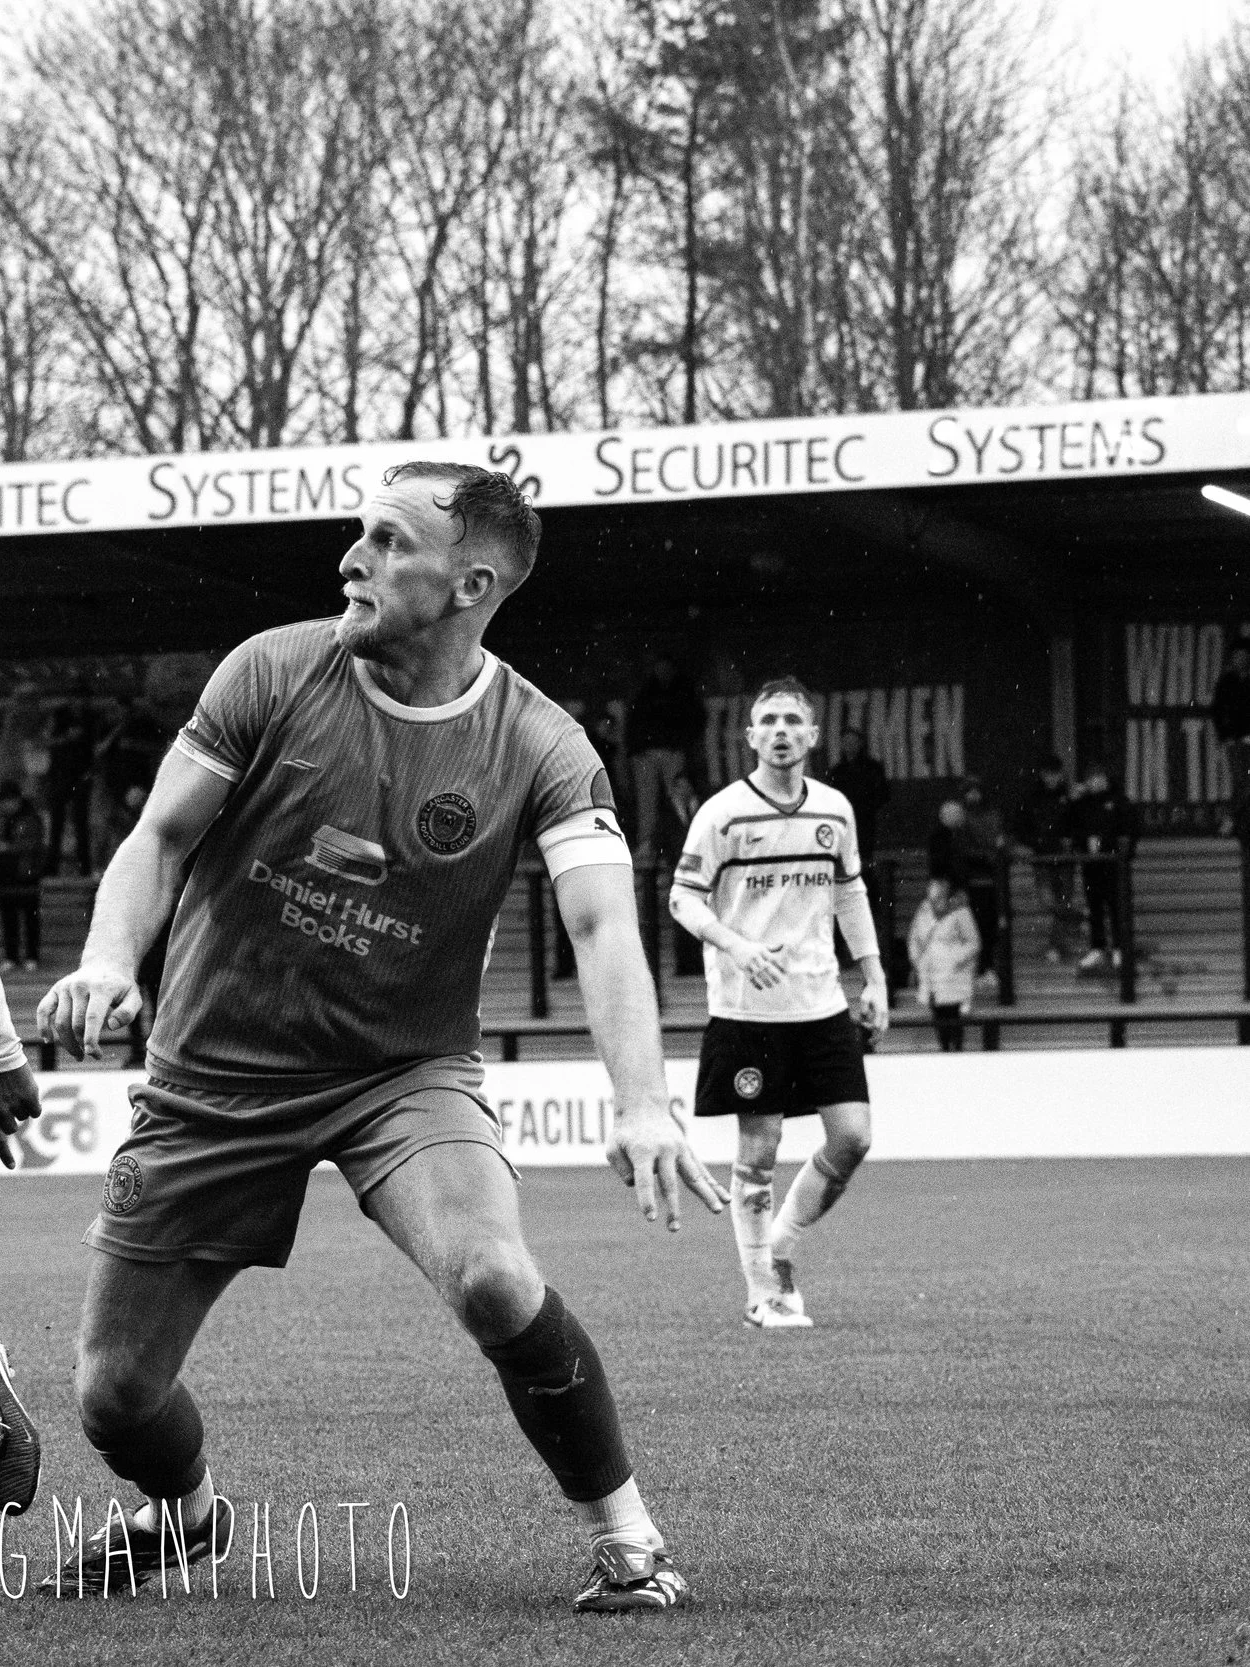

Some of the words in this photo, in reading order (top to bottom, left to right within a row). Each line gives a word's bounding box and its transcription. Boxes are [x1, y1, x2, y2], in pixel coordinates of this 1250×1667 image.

[595, 435, 866, 496] SECURITEC
[927, 417, 1166, 477] SYSTEMS
[147, 462, 365, 521] SYSTEMS
[248, 858, 337, 915] Daniel
[340, 898, 423, 945] Hurst
[745, 875, 775, 890] THE
[281, 901, 371, 956] Books
